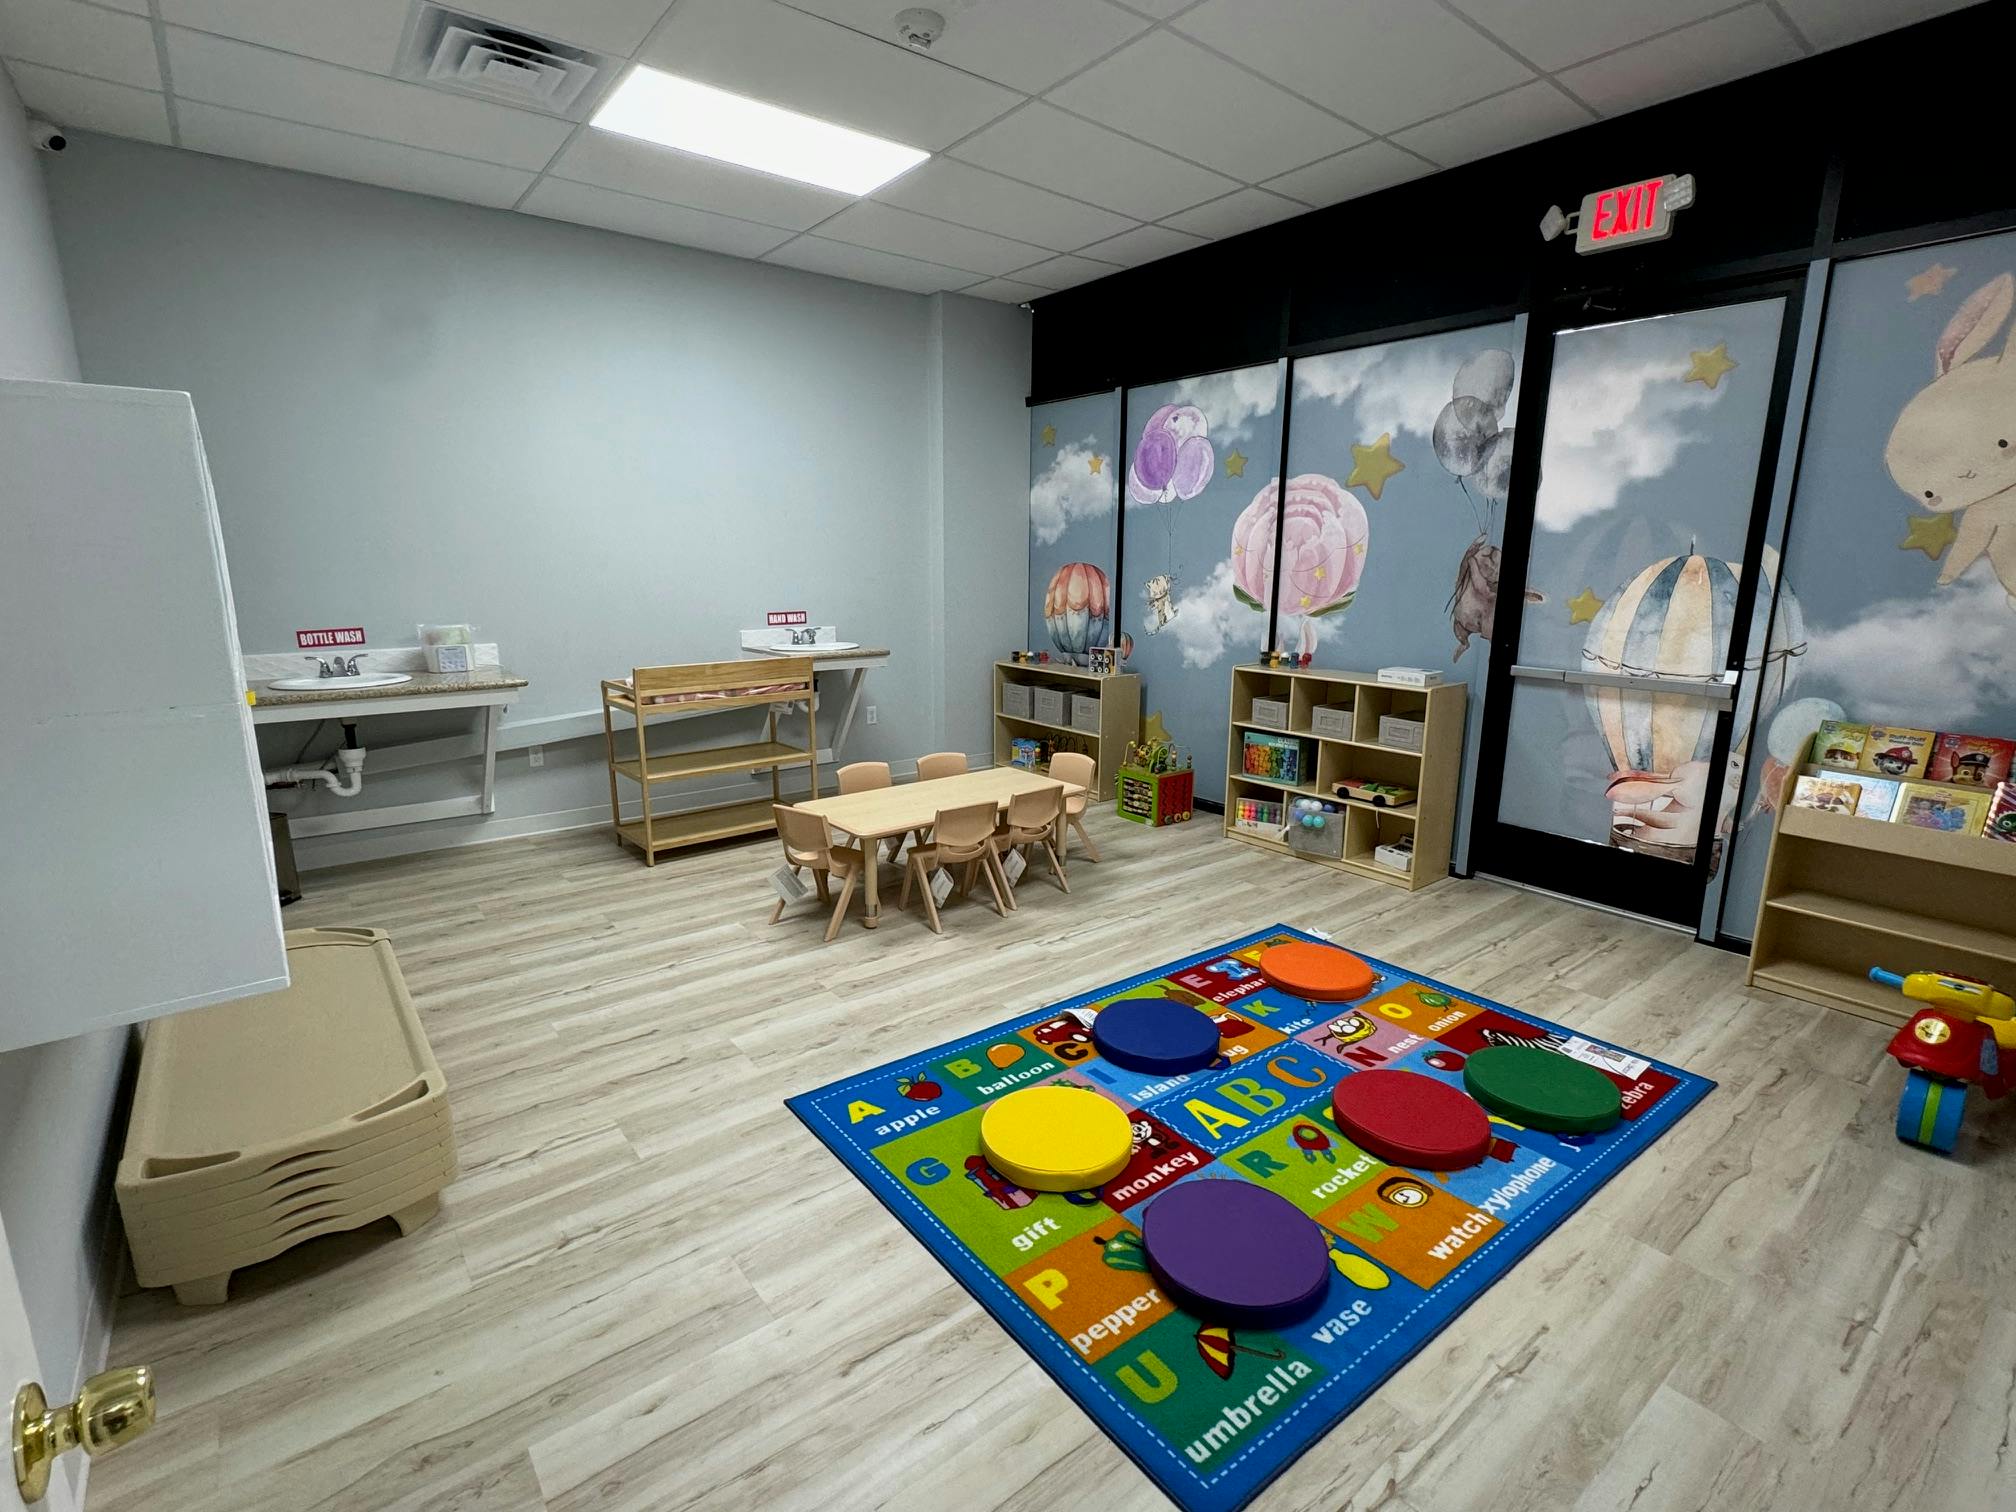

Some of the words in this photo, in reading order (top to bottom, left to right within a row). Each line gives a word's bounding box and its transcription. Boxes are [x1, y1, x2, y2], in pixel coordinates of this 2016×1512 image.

[1591, 179, 1664, 241] EXIT
[769, 614, 786, 624] HAND
[787, 613, 806, 623] WASH
[300, 632, 334, 646] BOTTLE
[334, 630, 362, 644] WASH
[1179, 973, 1213, 989] E
[1242, 999, 1281, 1017] K
[1378, 1002, 1412, 1020] O
[1427, 1010, 1468, 1033] onion
[1277, 1017, 1315, 1035] kite
[1054, 1042, 1089, 1061] C
[1222, 1044, 1250, 1058] ug
[1343, 1045, 1389, 1068] N
[1387, 1032, 1425, 1054] nest
[943, 1058, 983, 1079] B
[976, 1060, 1056, 1096] balloon
[1127, 1073, 1192, 1102] island
[847, 1100, 887, 1125] A
[874, 1104, 942, 1137] apple
[905, 1156, 952, 1186] G
[1111, 1150, 1200, 1202] monkey
[1236, 1150, 1290, 1179] R
[1311, 1153, 1378, 1200] rocket
[1477, 1156, 1557, 1215] xylophone
[1011, 1216, 1063, 1252] gift
[1336, 1201, 1400, 1244] W
[1427, 1212, 1493, 1260] watch
[1022, 1268, 1070, 1311] P
[1070, 1288, 1161, 1355] pepper
[1311, 1298, 1373, 1344] vase
[1115, 1348, 1179, 1404] U
[1184, 1360, 1313, 1463] umbrella
